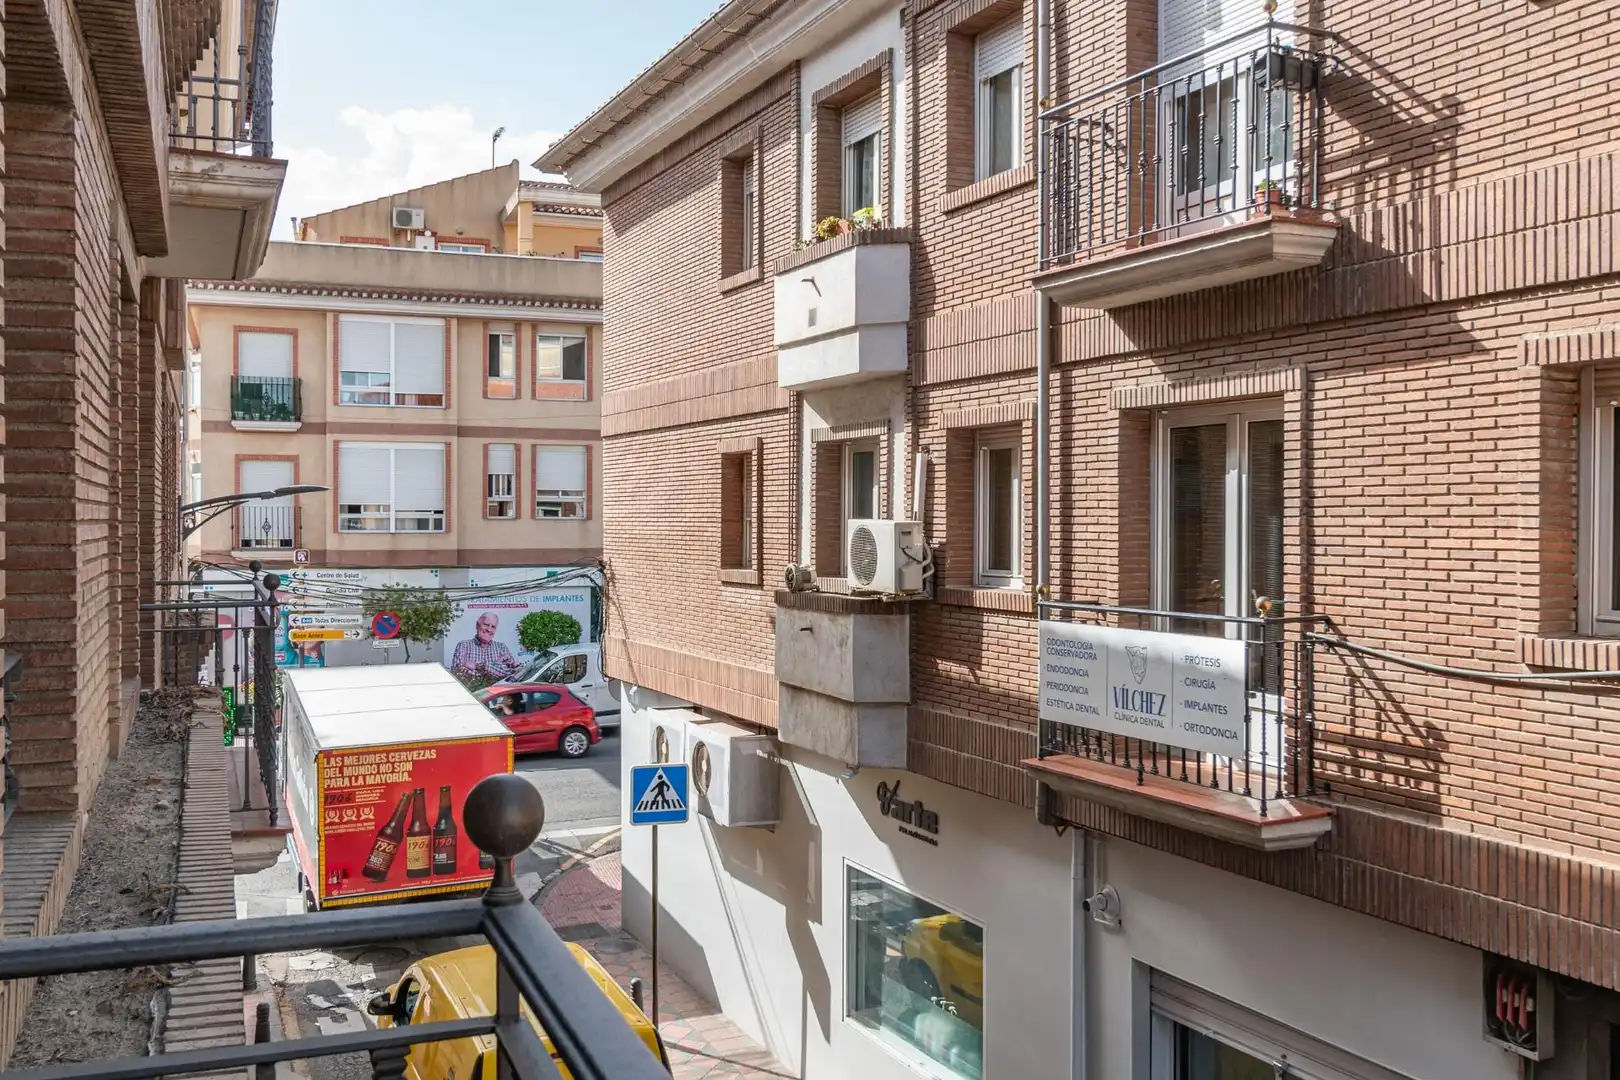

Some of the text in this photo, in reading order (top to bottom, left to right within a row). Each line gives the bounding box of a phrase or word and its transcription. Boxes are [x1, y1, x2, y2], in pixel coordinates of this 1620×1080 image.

[543, 594, 584, 602] IMPLANTES
[1046, 637, 1094, 650] ODONTOLOGÍA
[1046, 647, 1098, 660] CONSERVADORA
[1184, 654, 1221, 668] PRÓTESIS
[1046, 664, 1090, 678] ENDODONCIA
[1046, 681, 1089, 695] PERIODONCIA
[1184, 677, 1216, 690] CIRUGÍA
[1046, 698, 1100, 716] ESTÉTICA DENTAL
[1113, 684, 1167, 716] VÍLCHEZ
[1184, 700, 1228, 715] IMPLANTES
[1114, 711, 1165, 728] CLÍNICA DENTAL
[1184, 722, 1238, 740] ORTODONCIA
[324, 749, 437, 768] LAS MEJORES CERVEZAS
[324, 761, 413, 778] DEL MUNDO NO SON
[324, 771, 412, 788] PARA LA MAYORÍA.
[876, 780, 938, 834] Yarte
[370, 856, 383, 864] RED
